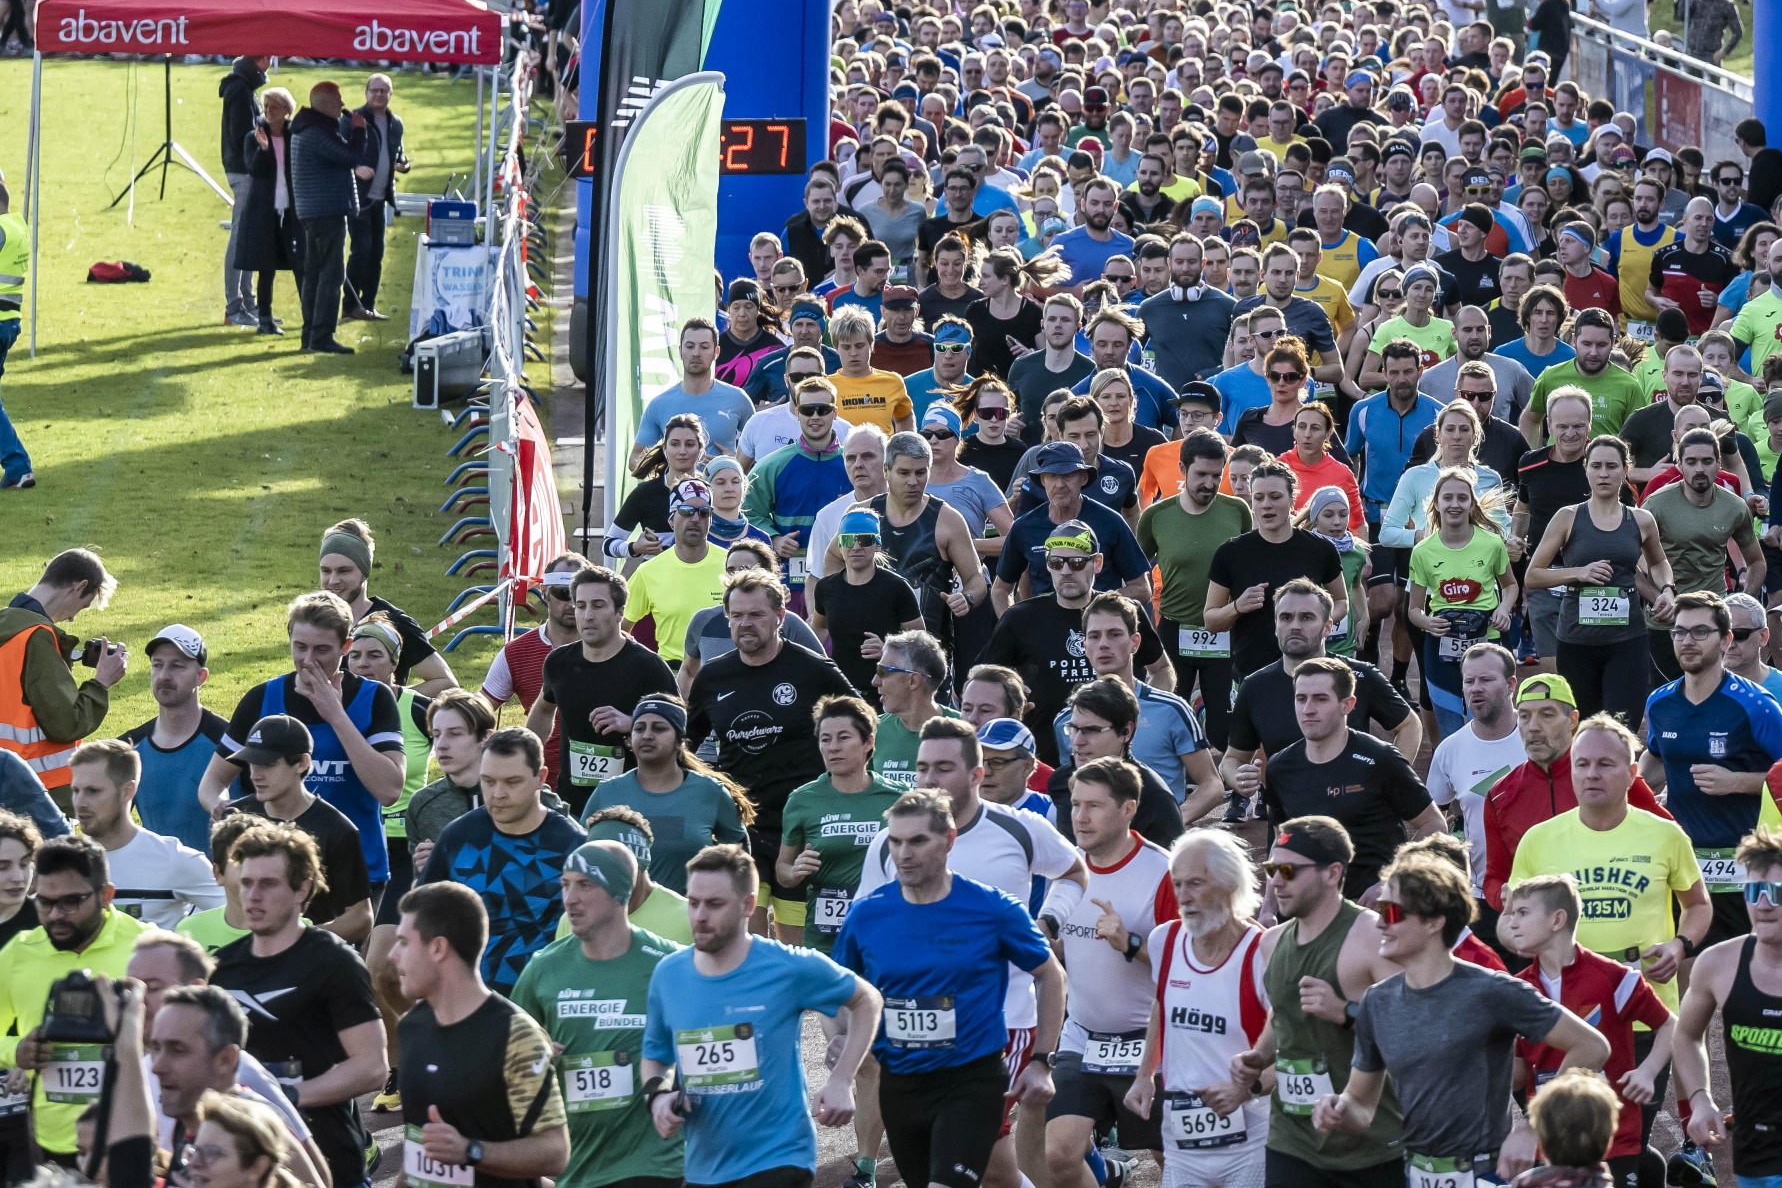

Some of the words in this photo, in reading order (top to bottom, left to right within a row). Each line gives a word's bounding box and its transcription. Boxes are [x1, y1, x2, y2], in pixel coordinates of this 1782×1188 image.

[58, 9, 190, 44] abavent
[353, 19, 481, 55] abavent
[1637, 326, 1653, 337] 613
[1443, 582, 1470, 596] Giro
[1591, 598, 1619, 612] 324
[1192, 632, 1217, 646] 992
[1662, 731, 1678, 739] JAKO
[580, 755, 609, 773] 962
[884, 761, 899, 769] AÜW
[1352, 753, 1370, 763] CRAFT
[820, 813, 842, 824] AÜW
[822, 822, 877, 835] ENERGIE
[1702, 861, 1736, 876] 494
[560, 1001, 621, 1015] ENERGIE
[599, 1014, 646, 1028] BÜNDEL
[897, 1012, 938, 1032] 5113
[1171, 1007, 1227, 1035] Högg
[695, 1042, 735, 1066] 265
[1098, 1041, 1143, 1059] 5155
[576, 1068, 612, 1091] 518
[1286, 1076, 1315, 1096] 668
[1181, 1113, 1231, 1135] 5695
